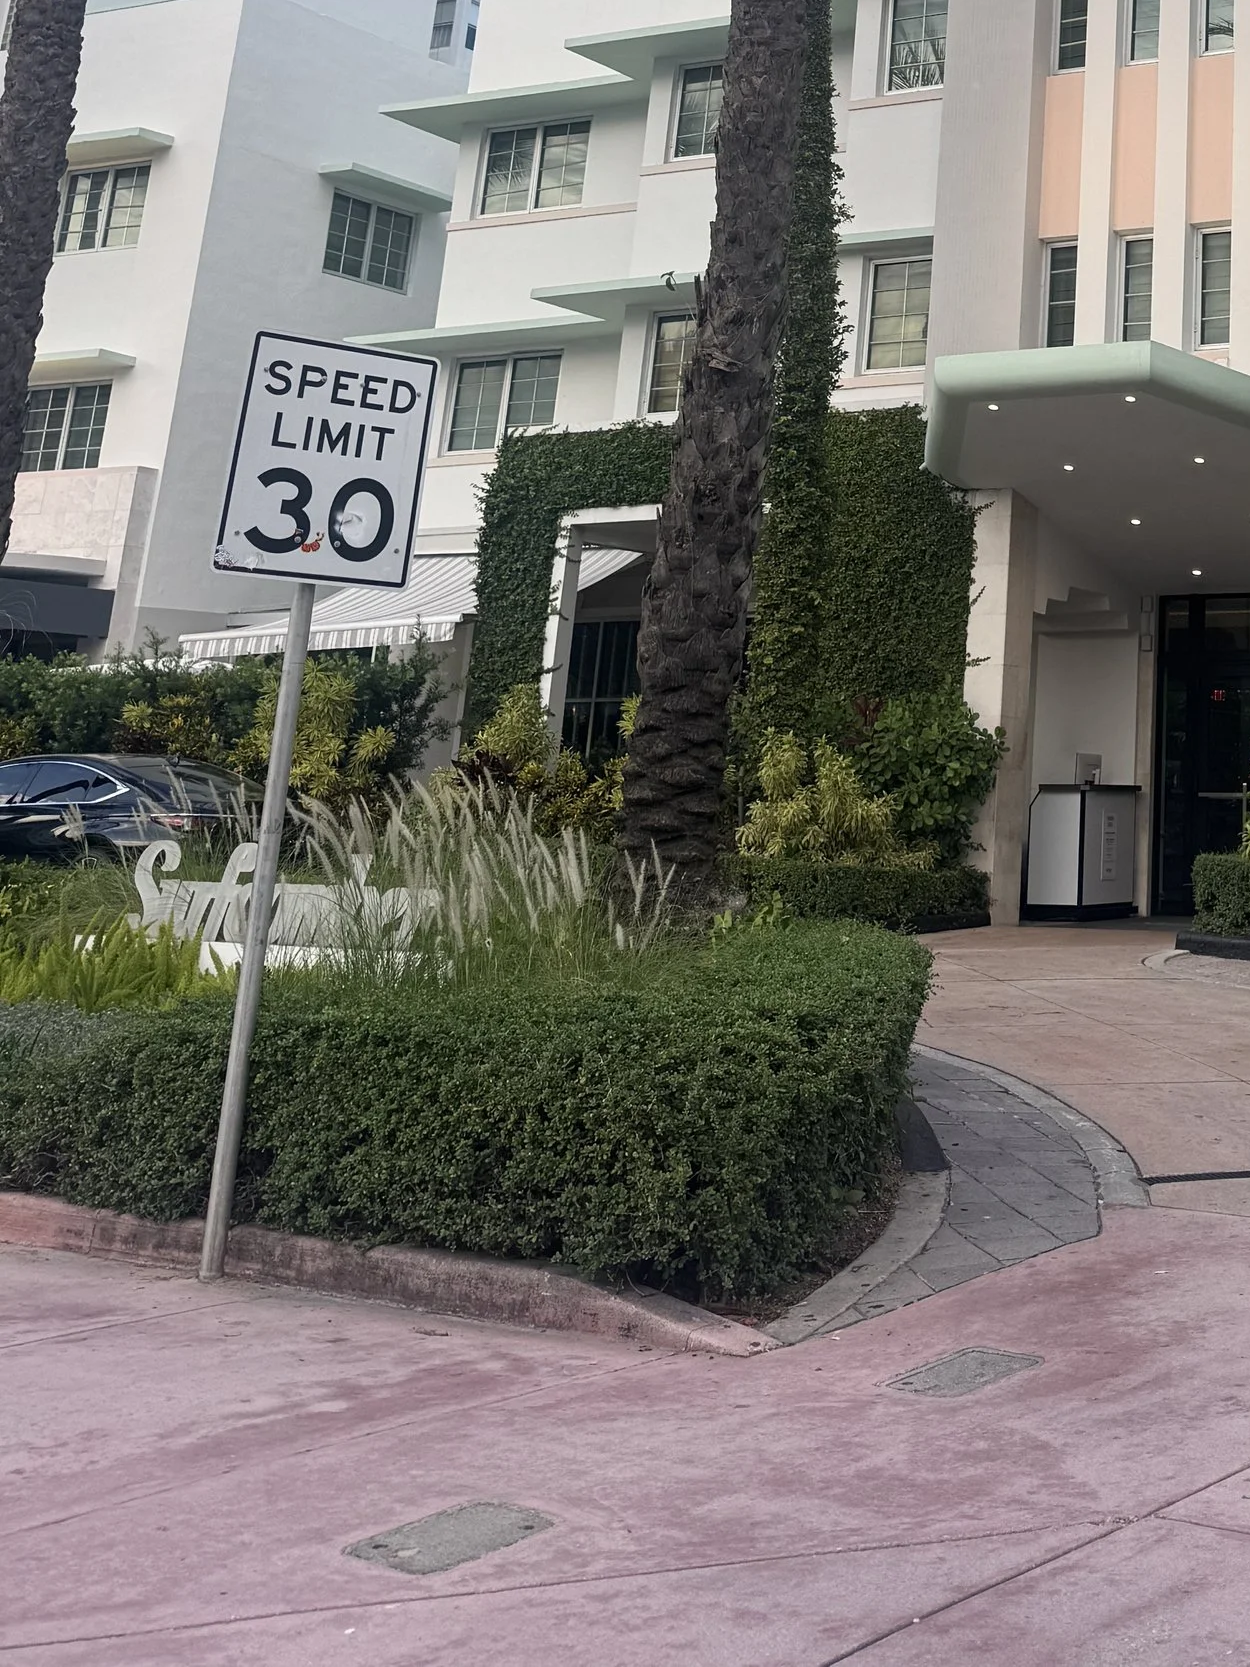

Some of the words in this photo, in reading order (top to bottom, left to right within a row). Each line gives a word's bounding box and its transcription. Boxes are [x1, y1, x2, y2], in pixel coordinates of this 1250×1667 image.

[264, 360, 417, 414] SPEED
[271, 411, 395, 461] LIMIT
[243, 467, 395, 562] 30
